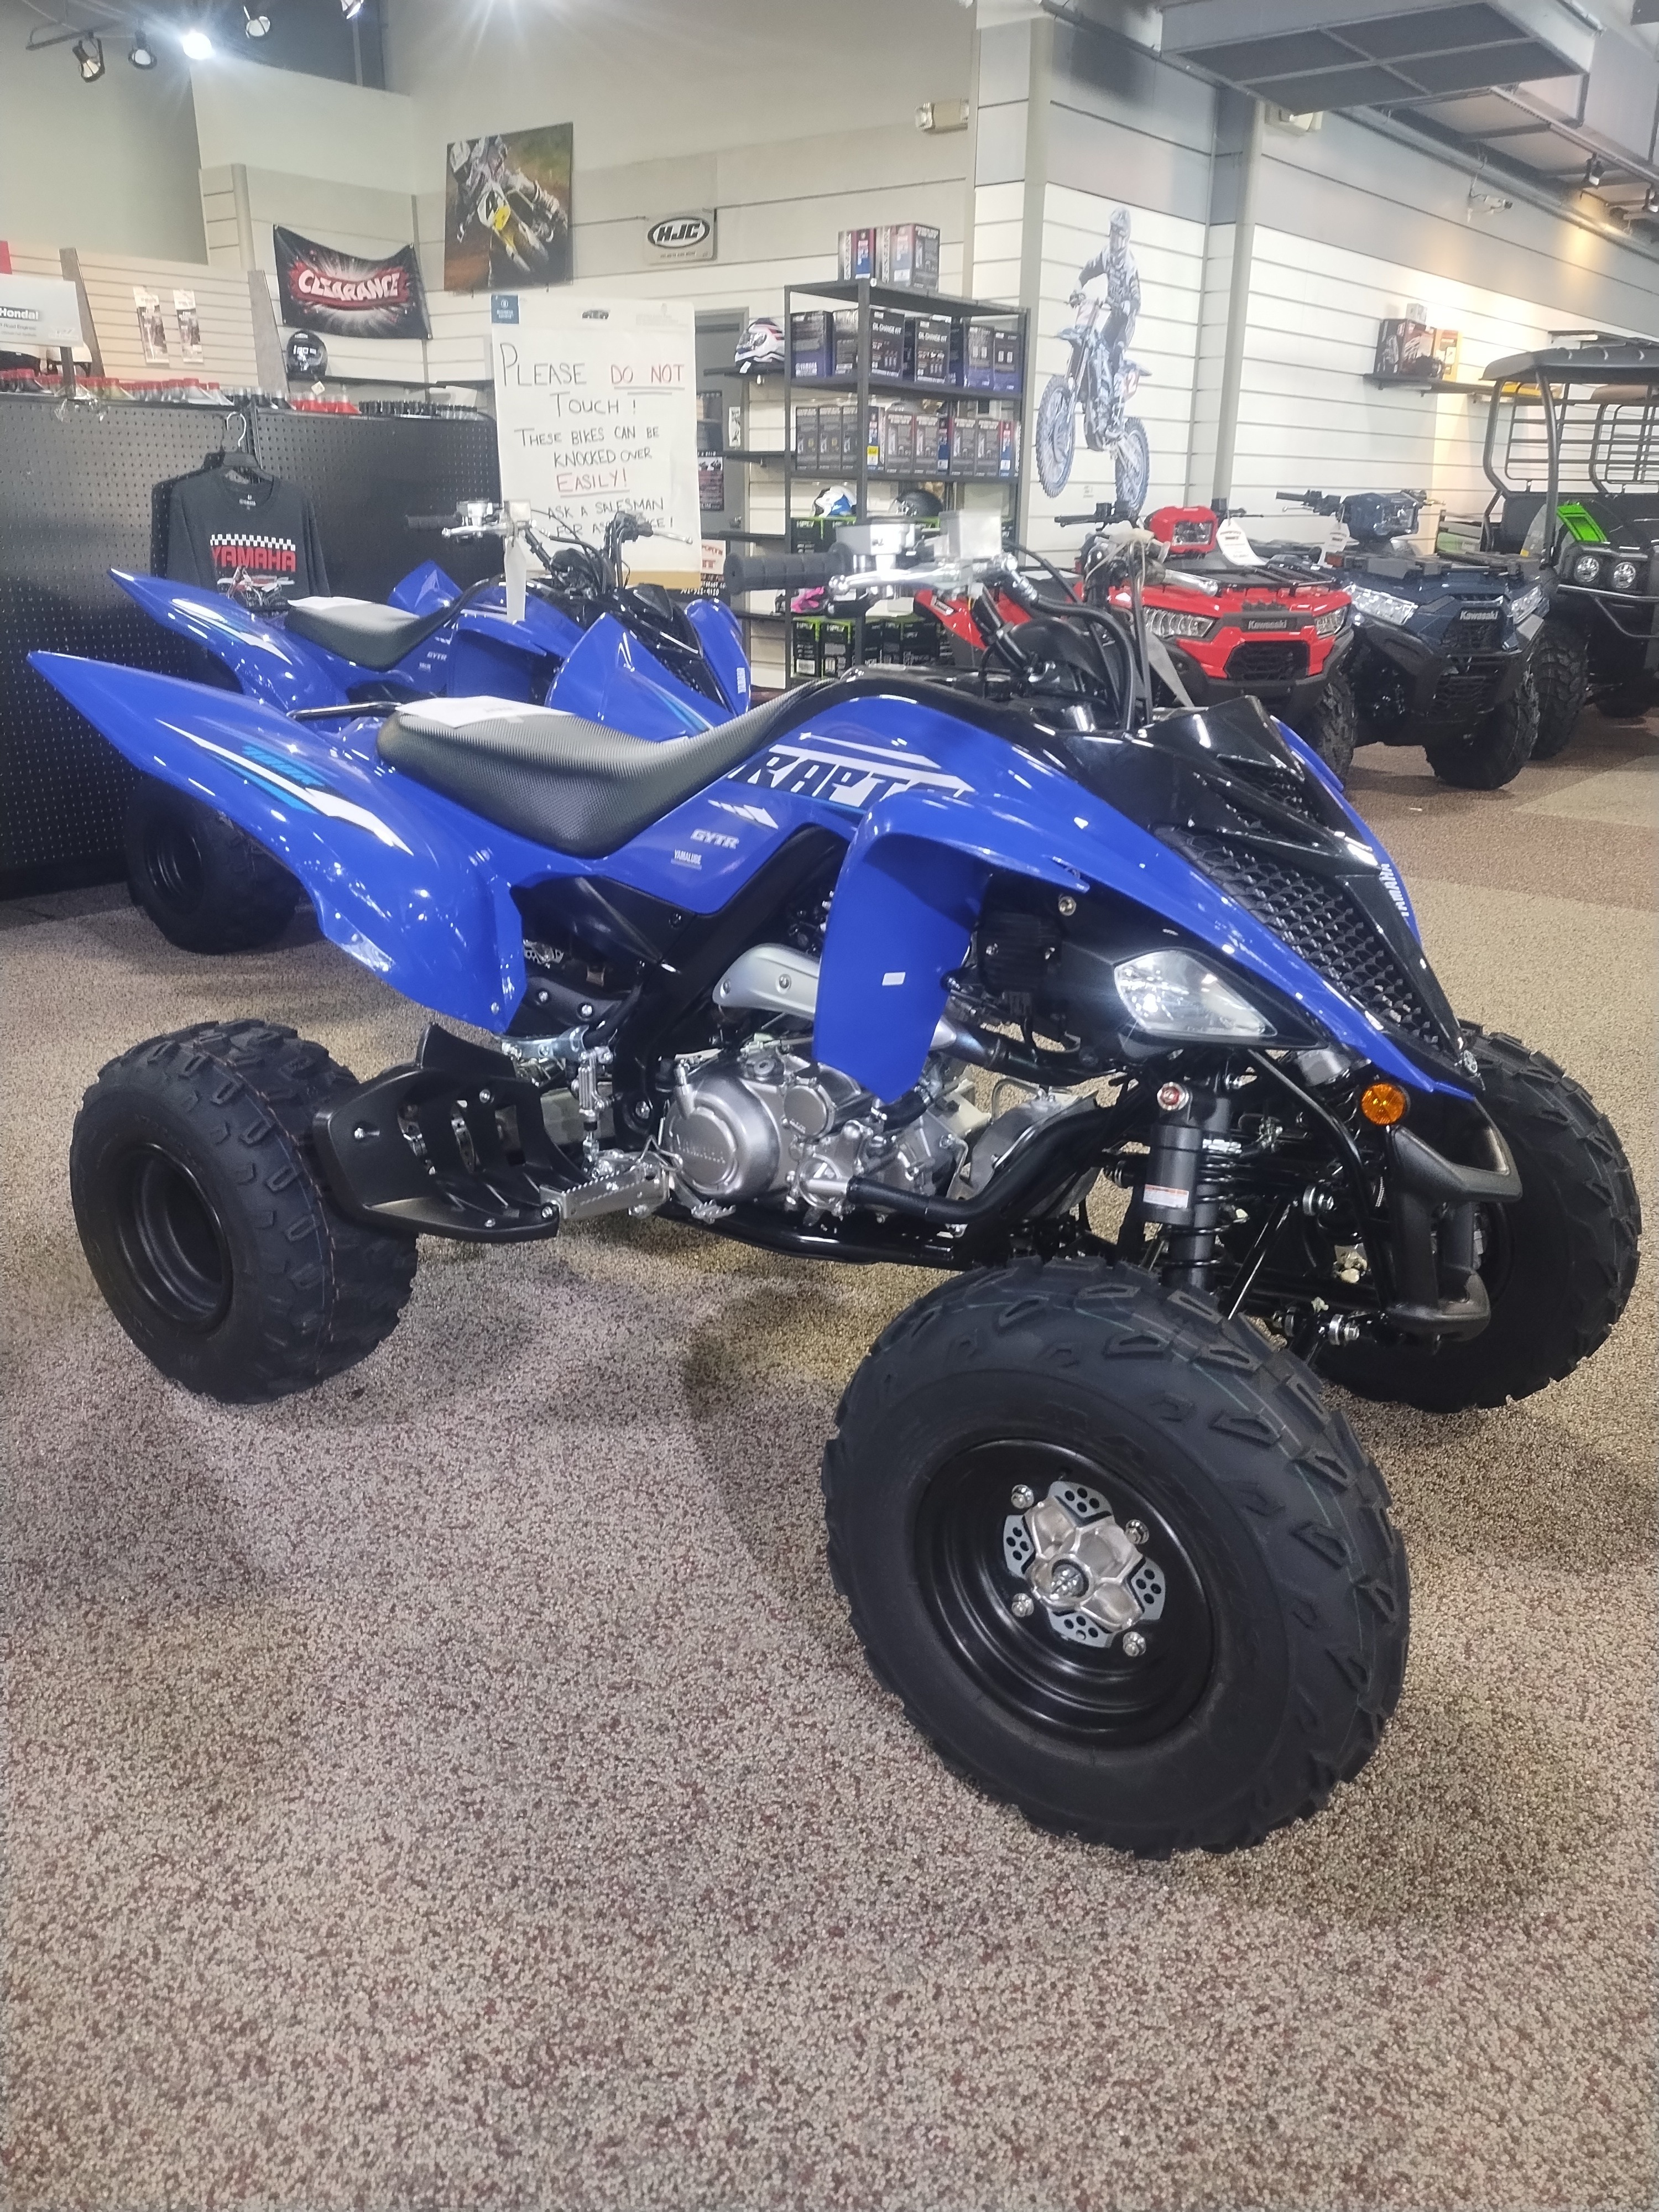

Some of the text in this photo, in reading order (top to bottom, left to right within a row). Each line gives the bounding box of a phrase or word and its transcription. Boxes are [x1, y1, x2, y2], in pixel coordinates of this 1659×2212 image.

[657, 223, 701, 241] HJC
[298, 269, 400, 301] CLEARANCE
[500, 342, 685, 387] PLEASE DO NOT
[550, 391, 619, 418] TOUCH
[514, 425, 660, 447] THESE BIKES CAN BE
[554, 446, 653, 468] KNOCKED OVER
[556, 467, 628, 492] EASILY!
[547, 497, 664, 520] ASK A SALESMAN
[556, 524, 583, 538] FOR
[211, 545, 296, 572] YAMAHA
[1248, 619, 1287, 630] Kawasaki
[1460, 611, 1499, 620] Kawasaki
[426, 651, 447, 661] GYTR
[731, 752, 971, 813] RAPT
[690, 828, 740, 849] GYTR
[674, 849, 702, 865] YAMALUBE
[1379, 863, 1410, 917] YAMAHA
